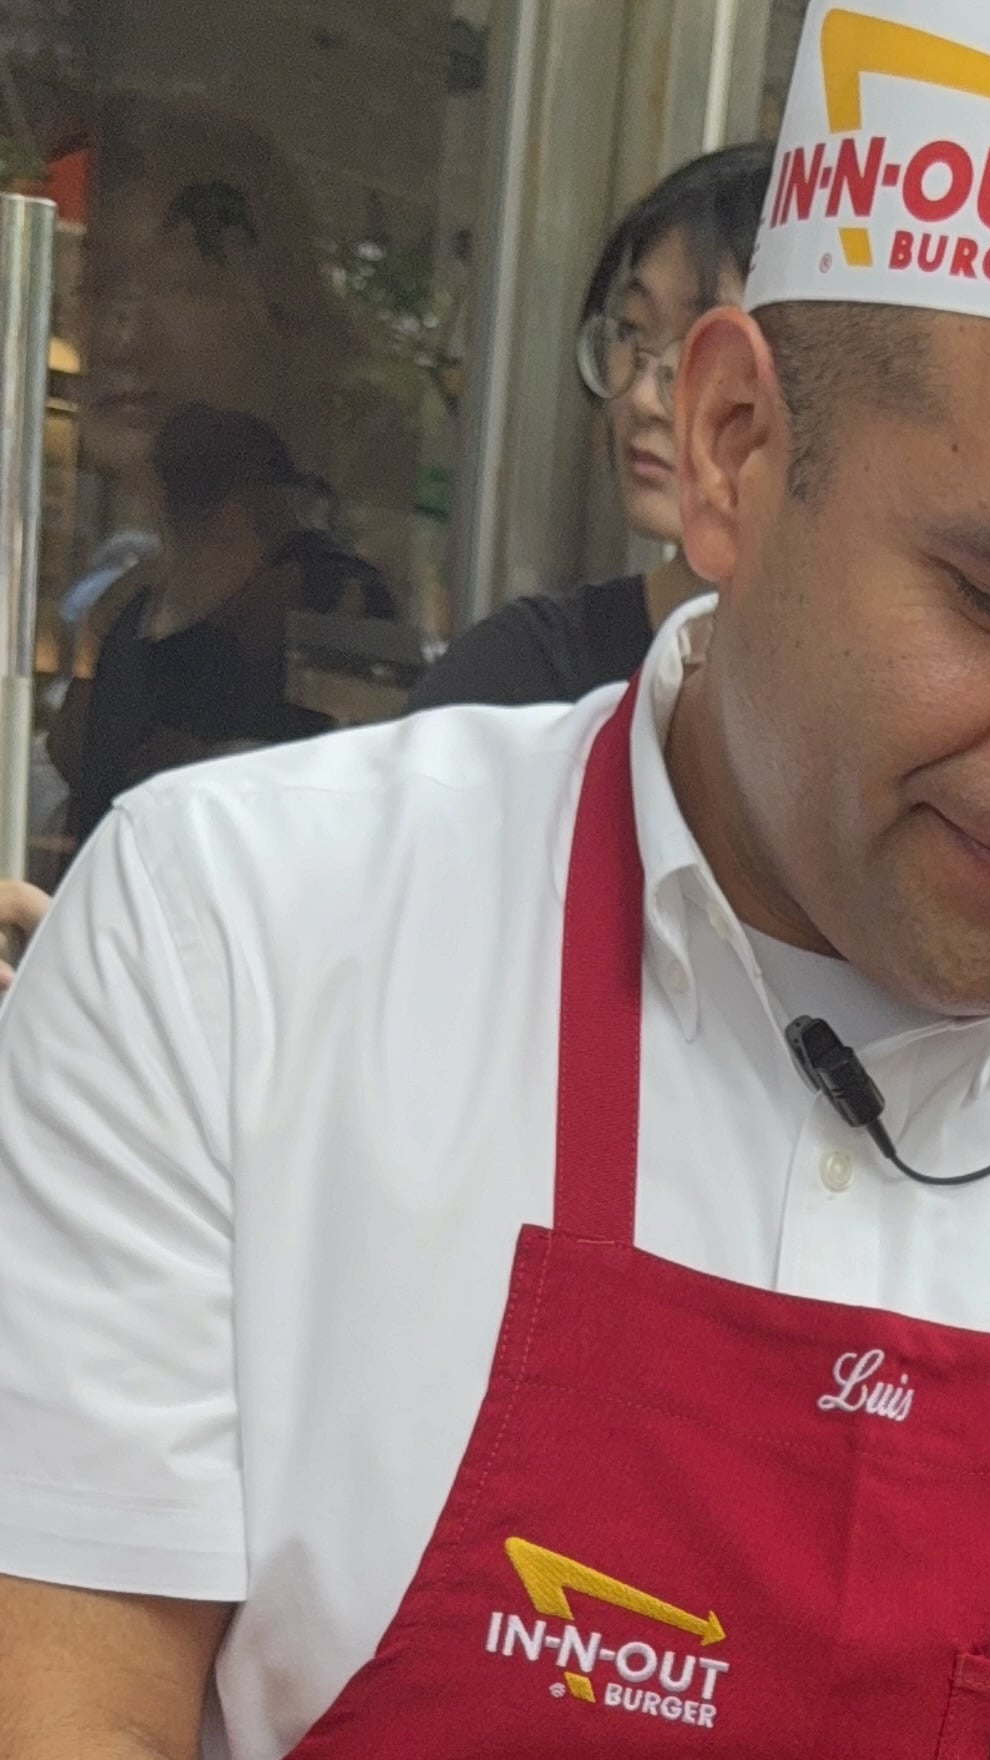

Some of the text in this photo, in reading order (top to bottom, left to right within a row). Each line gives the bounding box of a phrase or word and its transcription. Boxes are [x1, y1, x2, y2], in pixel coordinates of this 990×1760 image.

[817, 1349, 914, 1421] Luis
[485, 1612, 730, 1700] IN-N-OUT
[604, 1683, 717, 1728] BURGER
